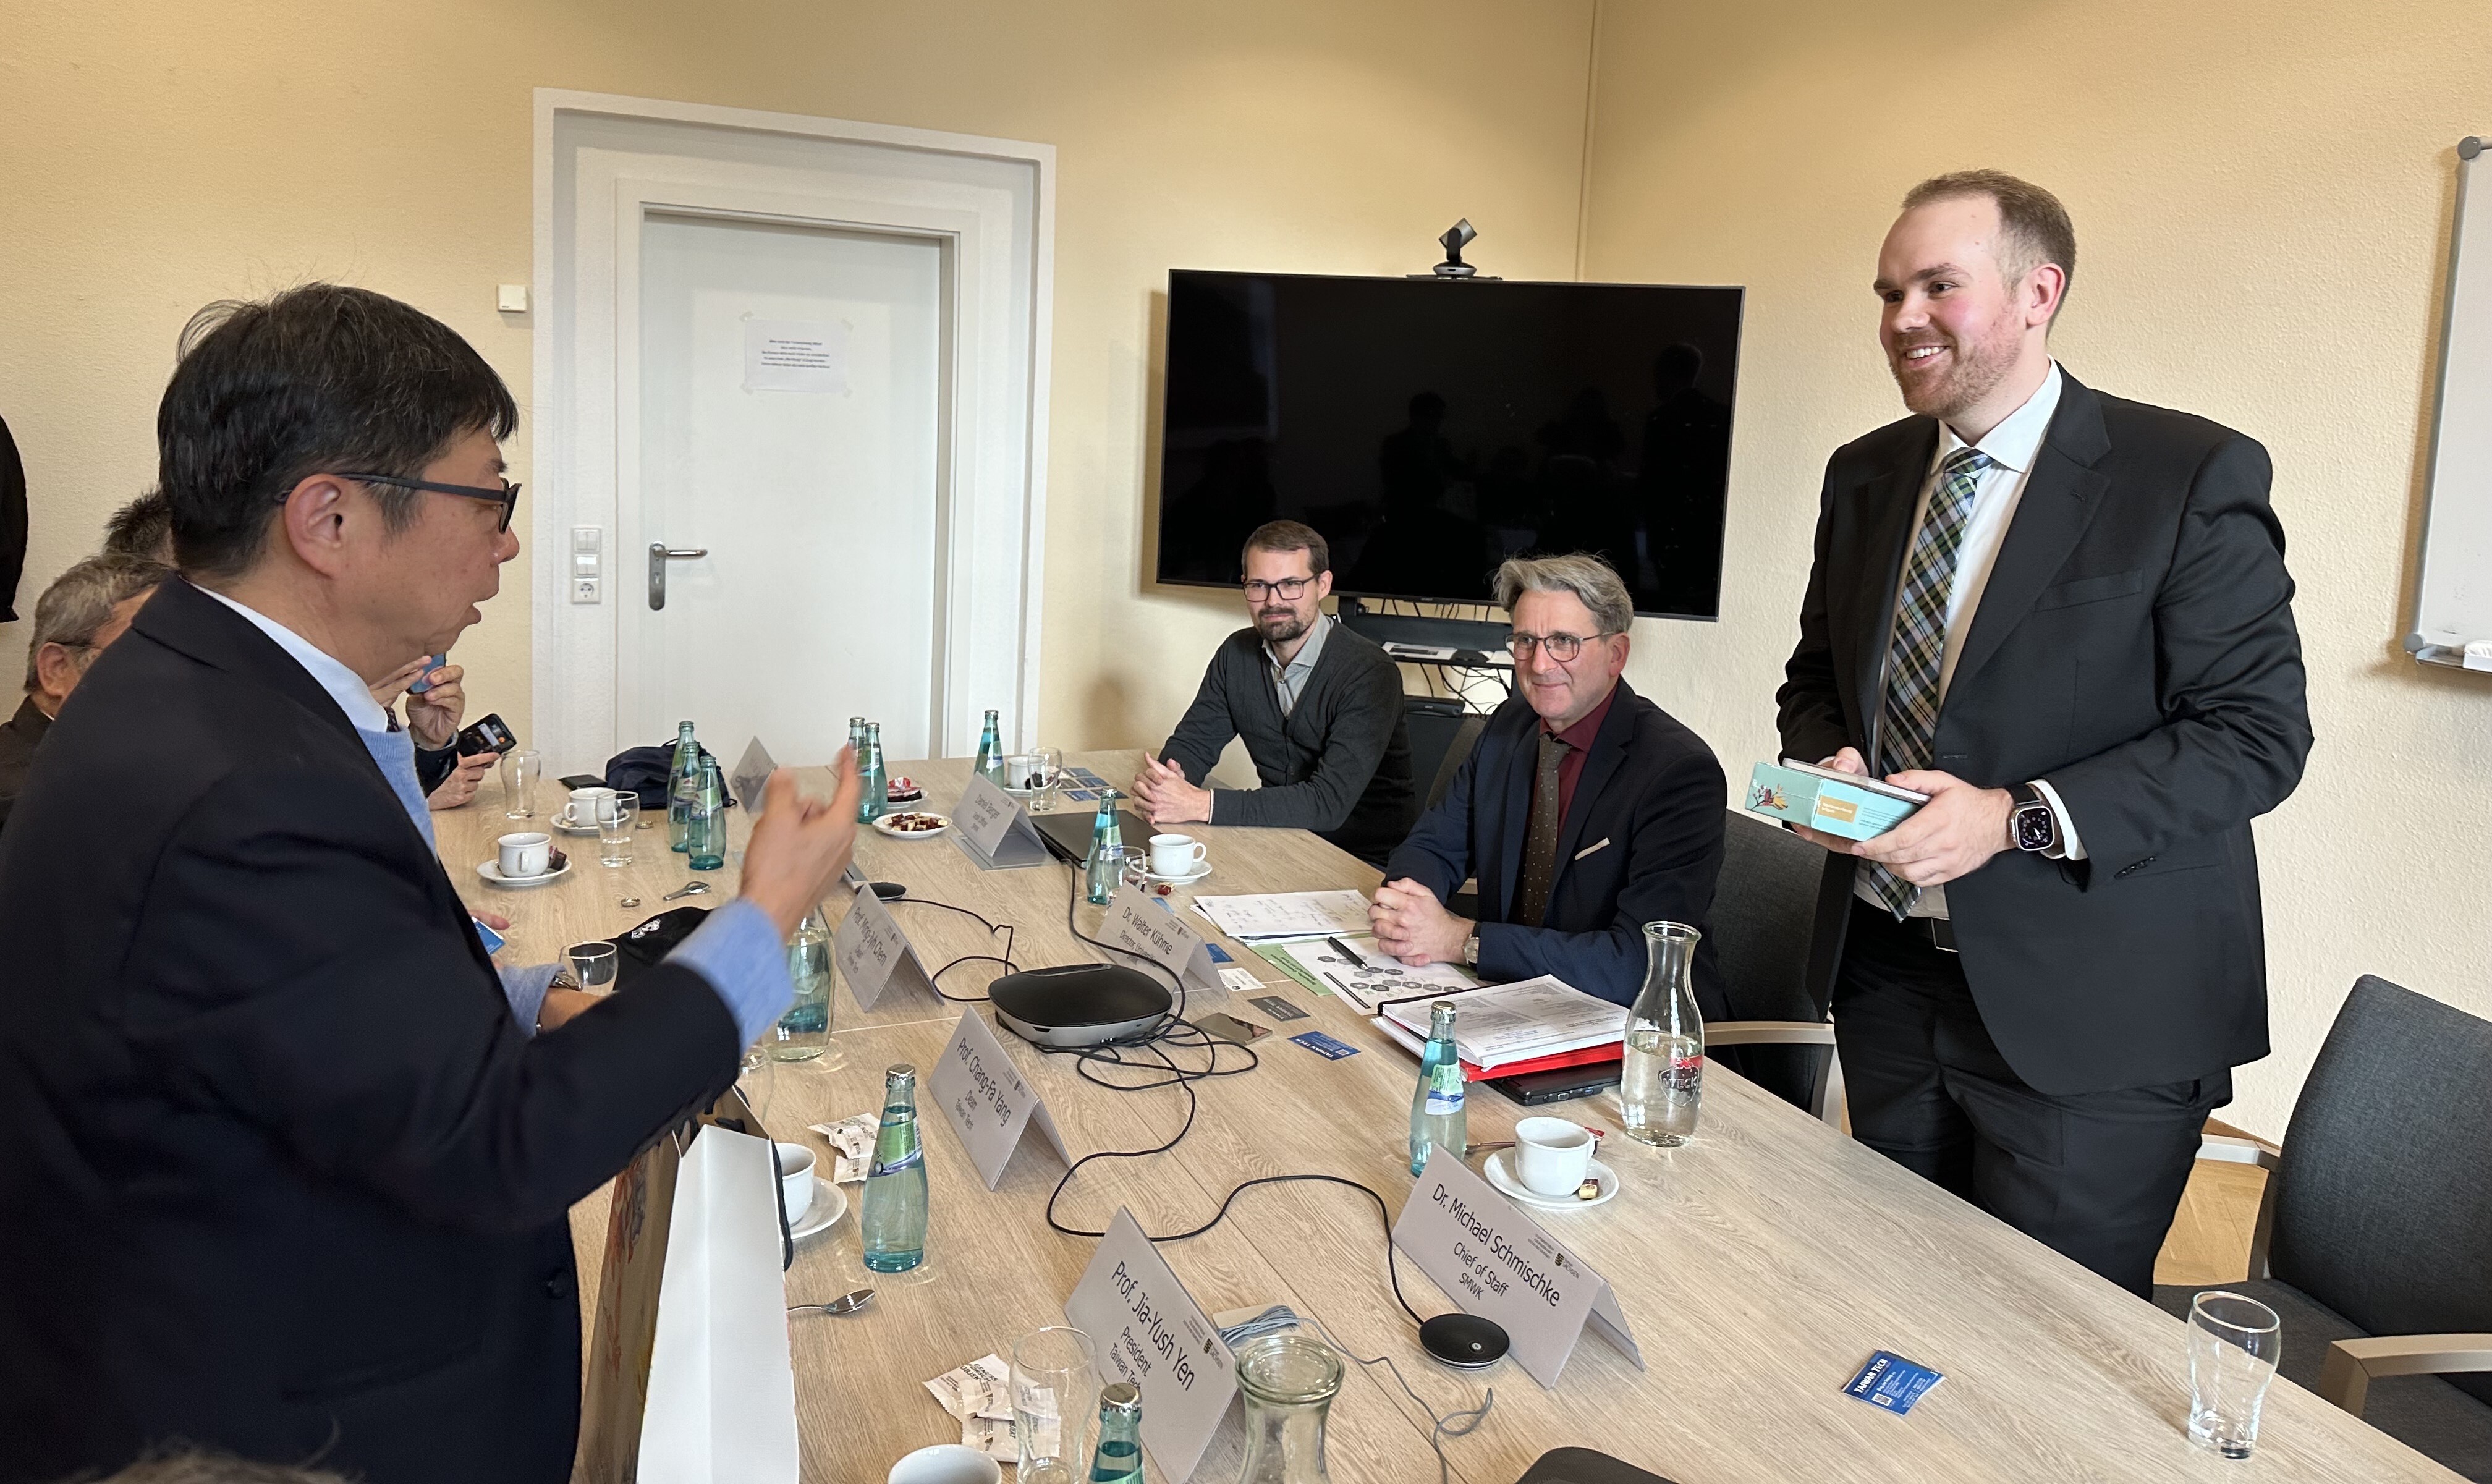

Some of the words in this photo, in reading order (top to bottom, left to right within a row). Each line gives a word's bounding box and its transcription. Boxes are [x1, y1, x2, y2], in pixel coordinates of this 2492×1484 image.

[1122, 906, 1131, 922] Dr.
[1132, 912, 1151, 936] Walter
[1150, 928, 1172, 955] Kühme
[957, 1037, 973, 1066] Prof.
[968, 1056, 996, 1101] Chang-Fa
[994, 1090, 1011, 1127] Yang
[965, 1090, 977, 1111] Dean
[1663, 1075, 1697, 1089] WECK
[1432, 1183, 1448, 1208] Dr.
[1448, 1197, 1493, 1245] Michael
[1490, 1235, 1561, 1307] Schmischke
[1454, 1242, 1478, 1269] Chief
[1475, 1261, 1488, 1278] of
[1485, 1270, 1509, 1297] Staff
[1459, 1272, 1485, 1300] SMWK
[1111, 1260, 1138, 1304] Prof.
[1132, 1292, 1174, 1360] Jia-Yush
[1172, 1347, 1195, 1391] Yen
[1109, 1342, 1128, 1380] Taiwan
[1120, 1326, 1152, 1378] President
[960, 1365, 981, 1381] OBJEK
[968, 1363, 992, 1382] FORSCH
[1854, 1372, 1877, 1393] TAIWAN
[1871, 1359, 1888, 1372] TECH
